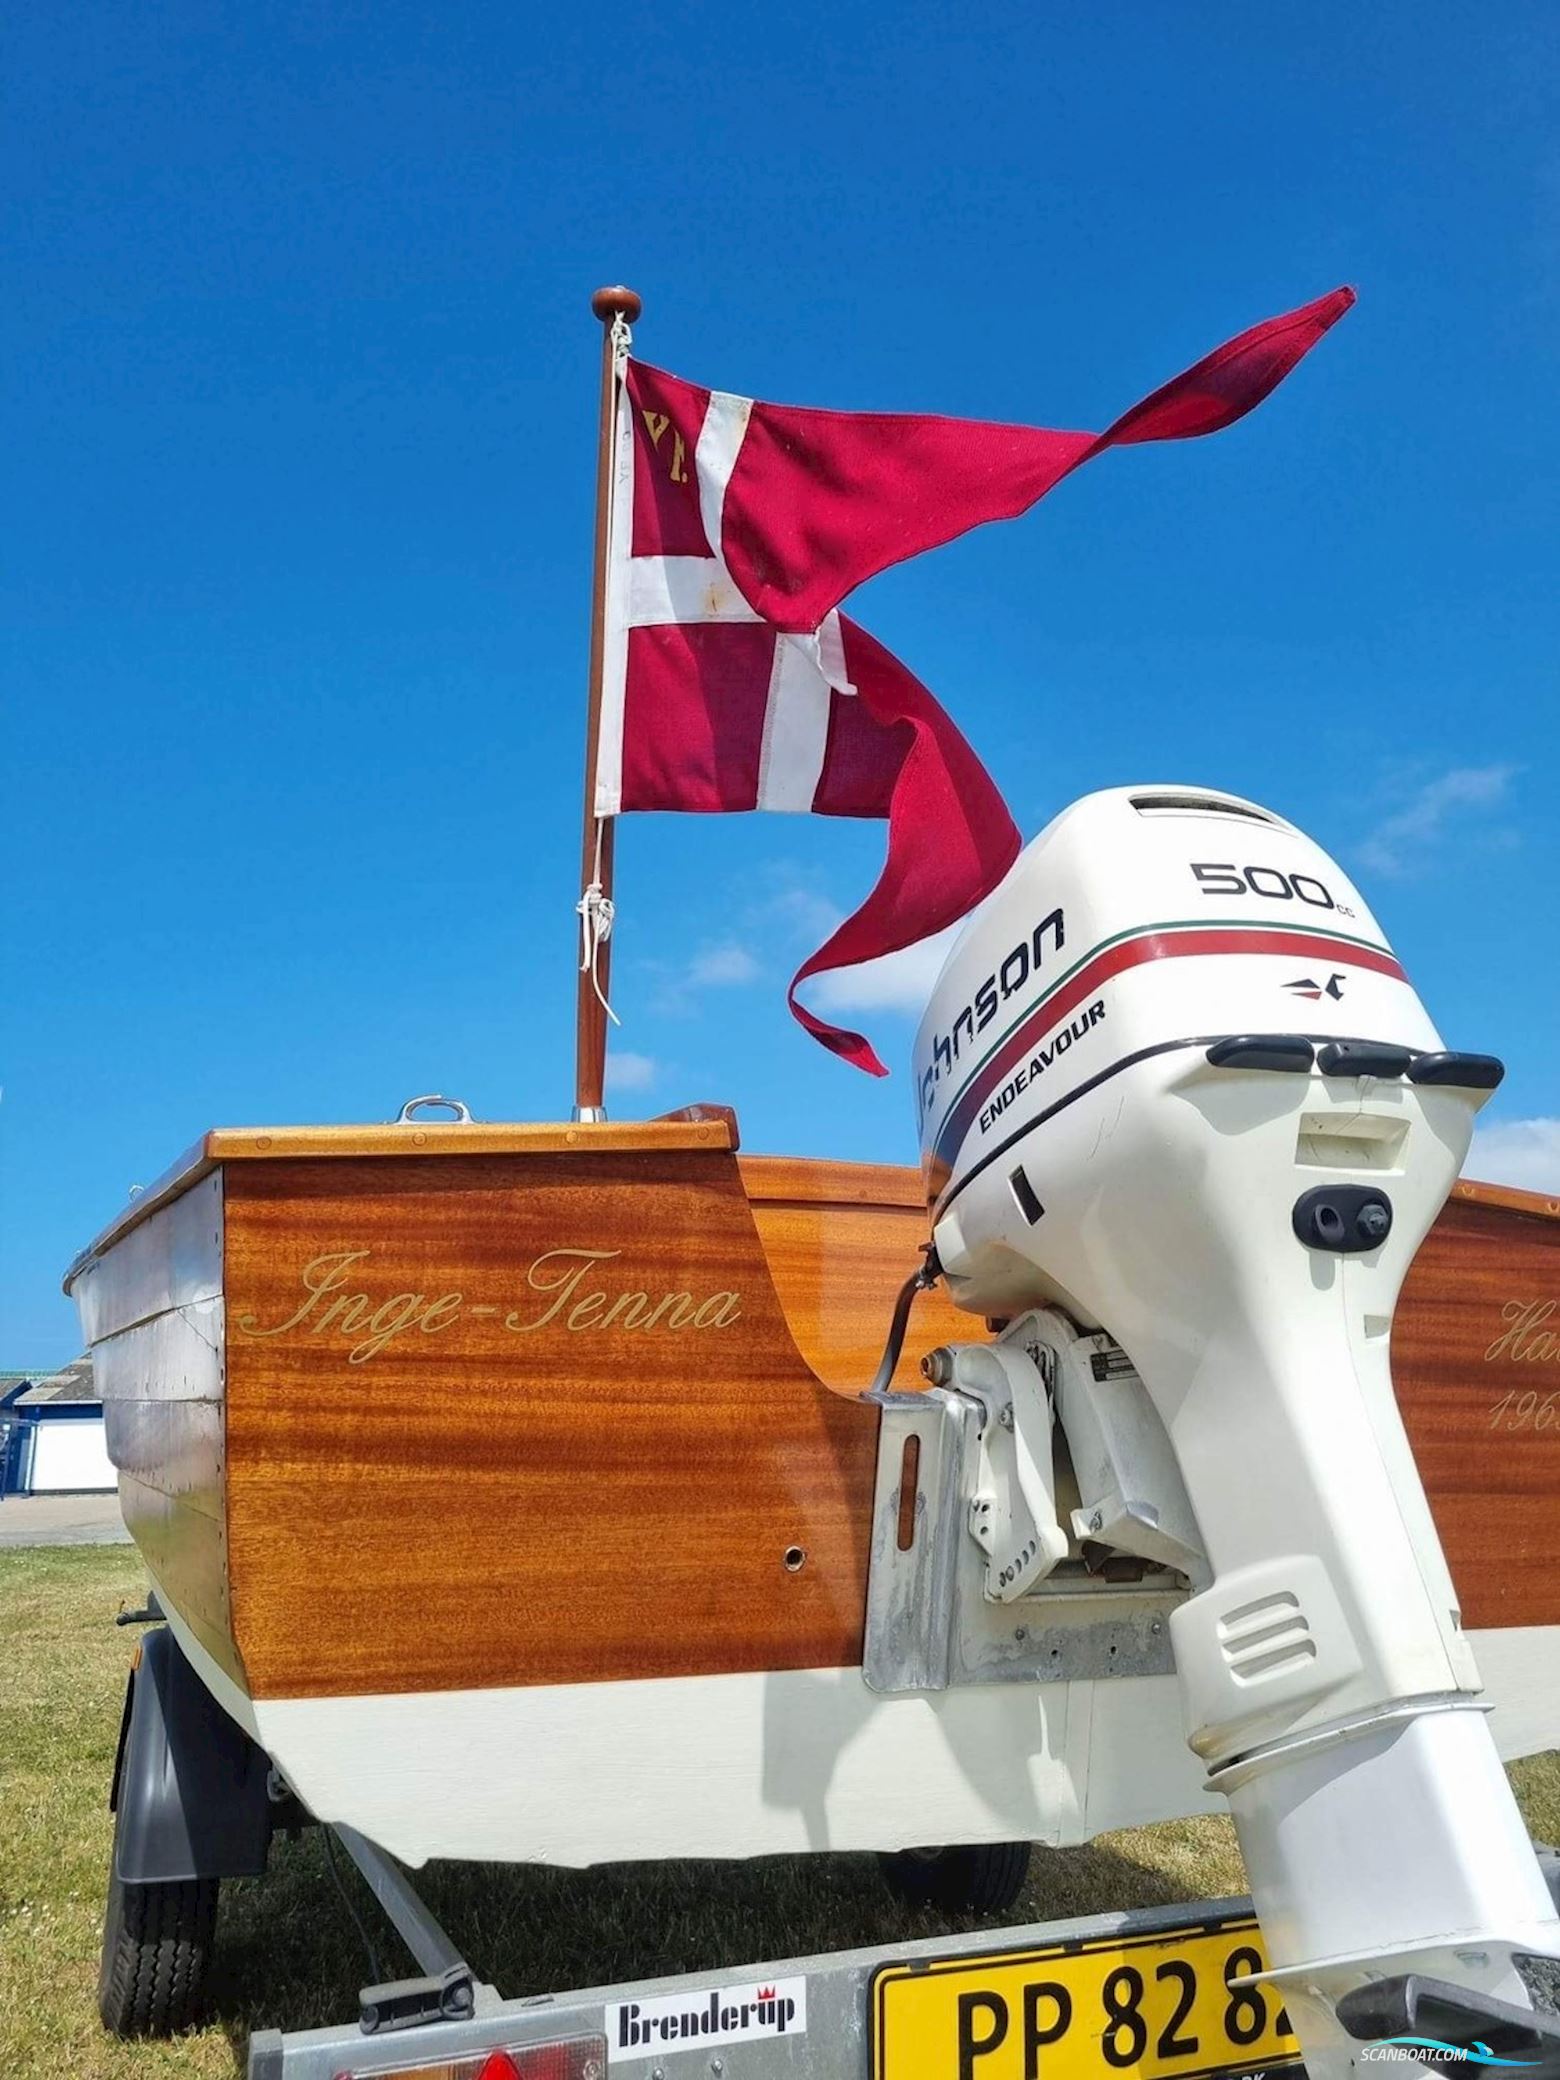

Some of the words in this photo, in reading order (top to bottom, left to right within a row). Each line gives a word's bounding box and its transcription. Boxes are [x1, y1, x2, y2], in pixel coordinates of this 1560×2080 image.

[1190, 864, 1334, 910] 500
[979, 1000, 1106, 1134] ENDEAVOUR
[1485, 1300, 1560, 1361] Ha
[1489, 1390, 1560, 1431] 196
[619, 1992, 795, 2047] Brenderup
[958, 1981, 1072, 2080] PP
[1103, 1961, 1199, 2067] 82
[1224, 1946, 1294, 2045] 8
